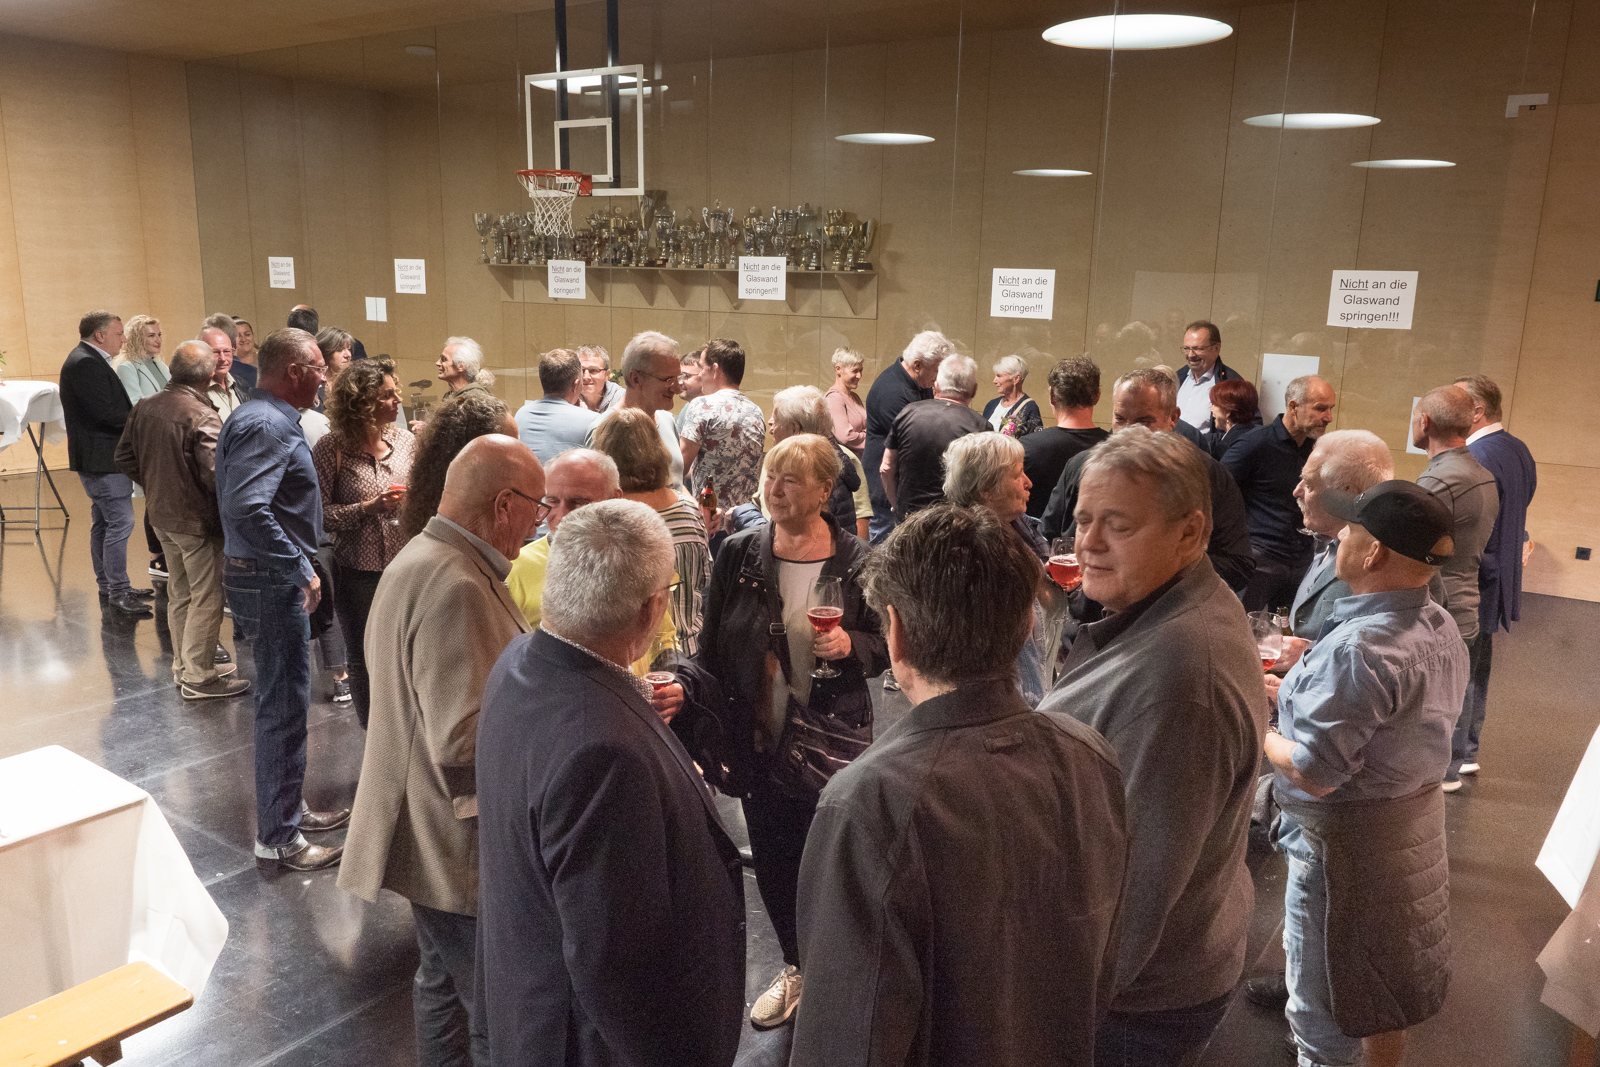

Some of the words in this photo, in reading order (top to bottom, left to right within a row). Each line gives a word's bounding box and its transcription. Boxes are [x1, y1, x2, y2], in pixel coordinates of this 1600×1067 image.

[743, 263, 760, 272] Nicht
[771, 263, 781, 271] die
[746, 274, 778, 283] Glaswand
[998, 276, 1020, 286] Nicht
[1035, 277, 1048, 285] die
[1339, 279, 1369, 291] Nicht
[1372, 281, 1386, 289] an
[1390, 280, 1407, 289] die
[745, 287, 778, 296] springen!!!
[1002, 289, 1043, 299] Glaswand
[1343, 294, 1400, 305] Glaswand
[999, 303, 1043, 314] springen!!!
[1340, 311, 1399, 323] springen!!!
